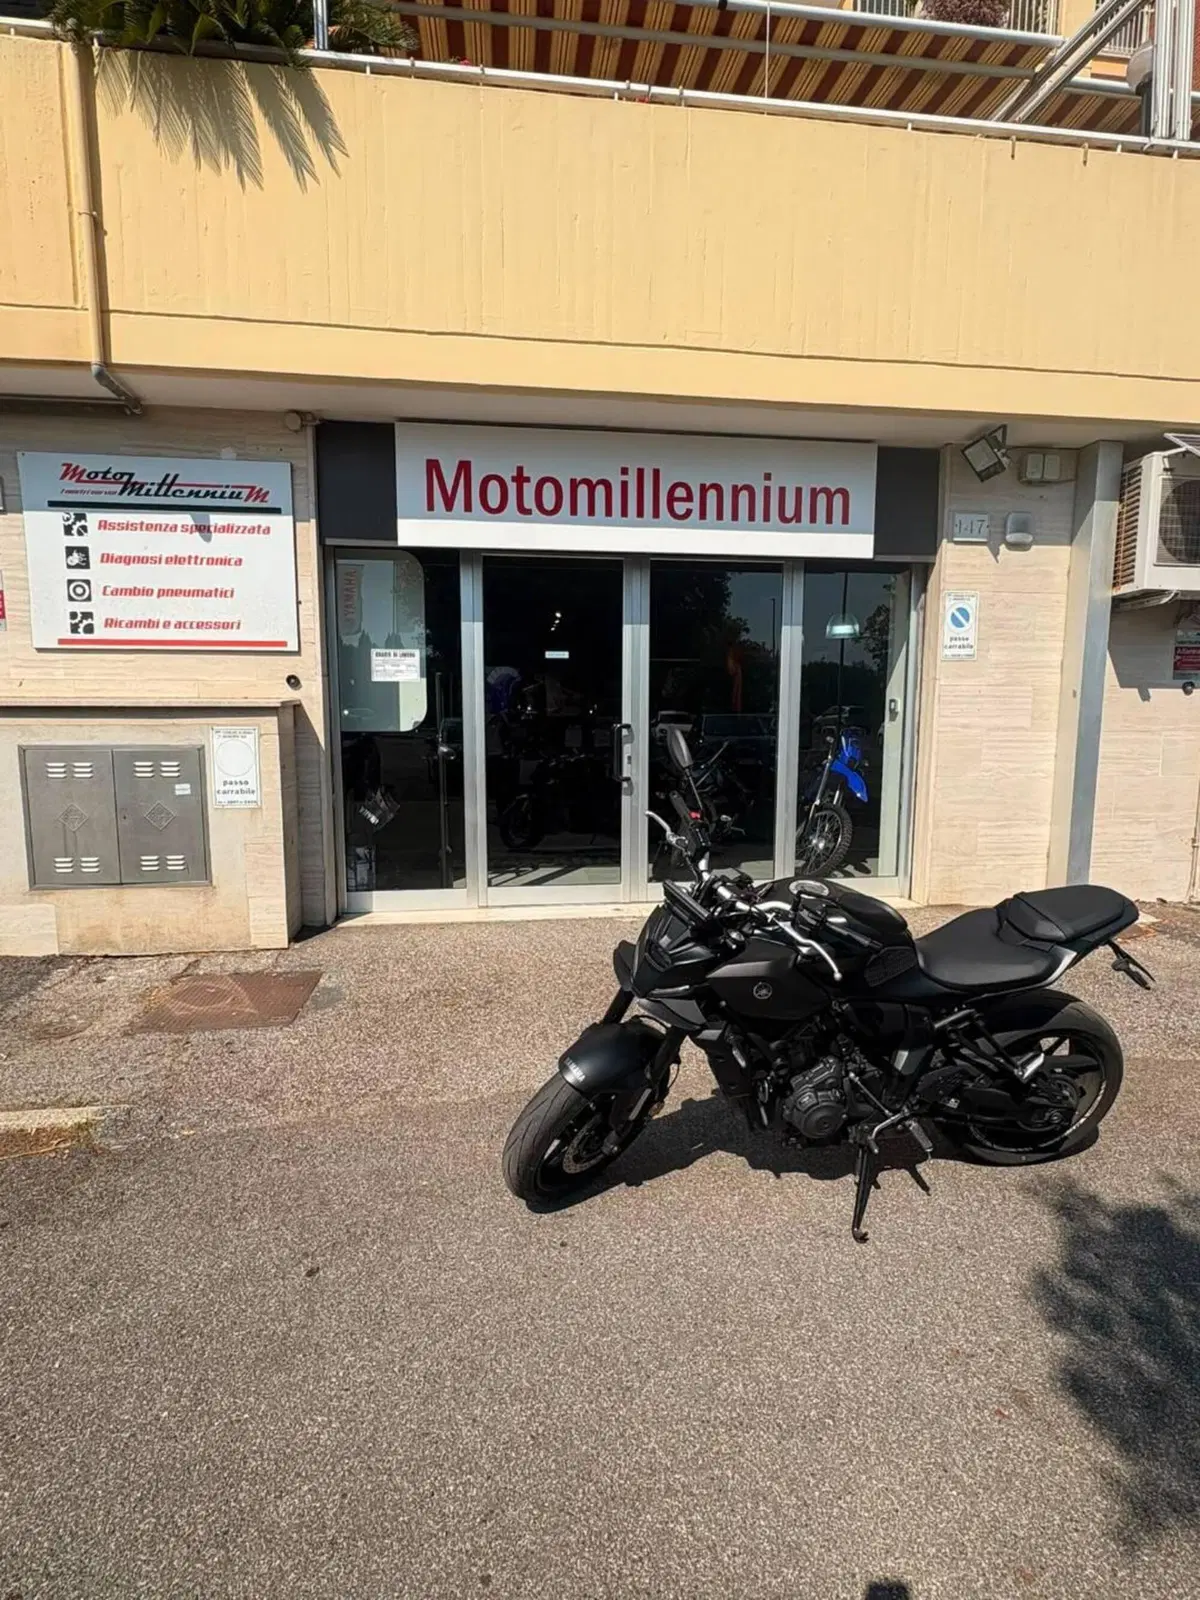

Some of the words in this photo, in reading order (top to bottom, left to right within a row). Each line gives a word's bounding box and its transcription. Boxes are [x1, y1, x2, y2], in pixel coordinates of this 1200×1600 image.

[59, 463, 135, 481] Moto
[425, 458, 850, 526] Motomillennium
[98, 519, 177, 533] Assistenza
[180, 522, 271, 536] specializzata
[100, 552, 162, 566] Diagnosi
[165, 554, 243, 567] elettronica
[102, 585, 154, 597] Cambio
[157, 587, 235, 599] pneumatici
[104, 617, 159, 630] Ricambi
[162, 620, 171, 629] e
[174, 619, 241, 630] accessori
[216, 788, 256, 796] carrabile
